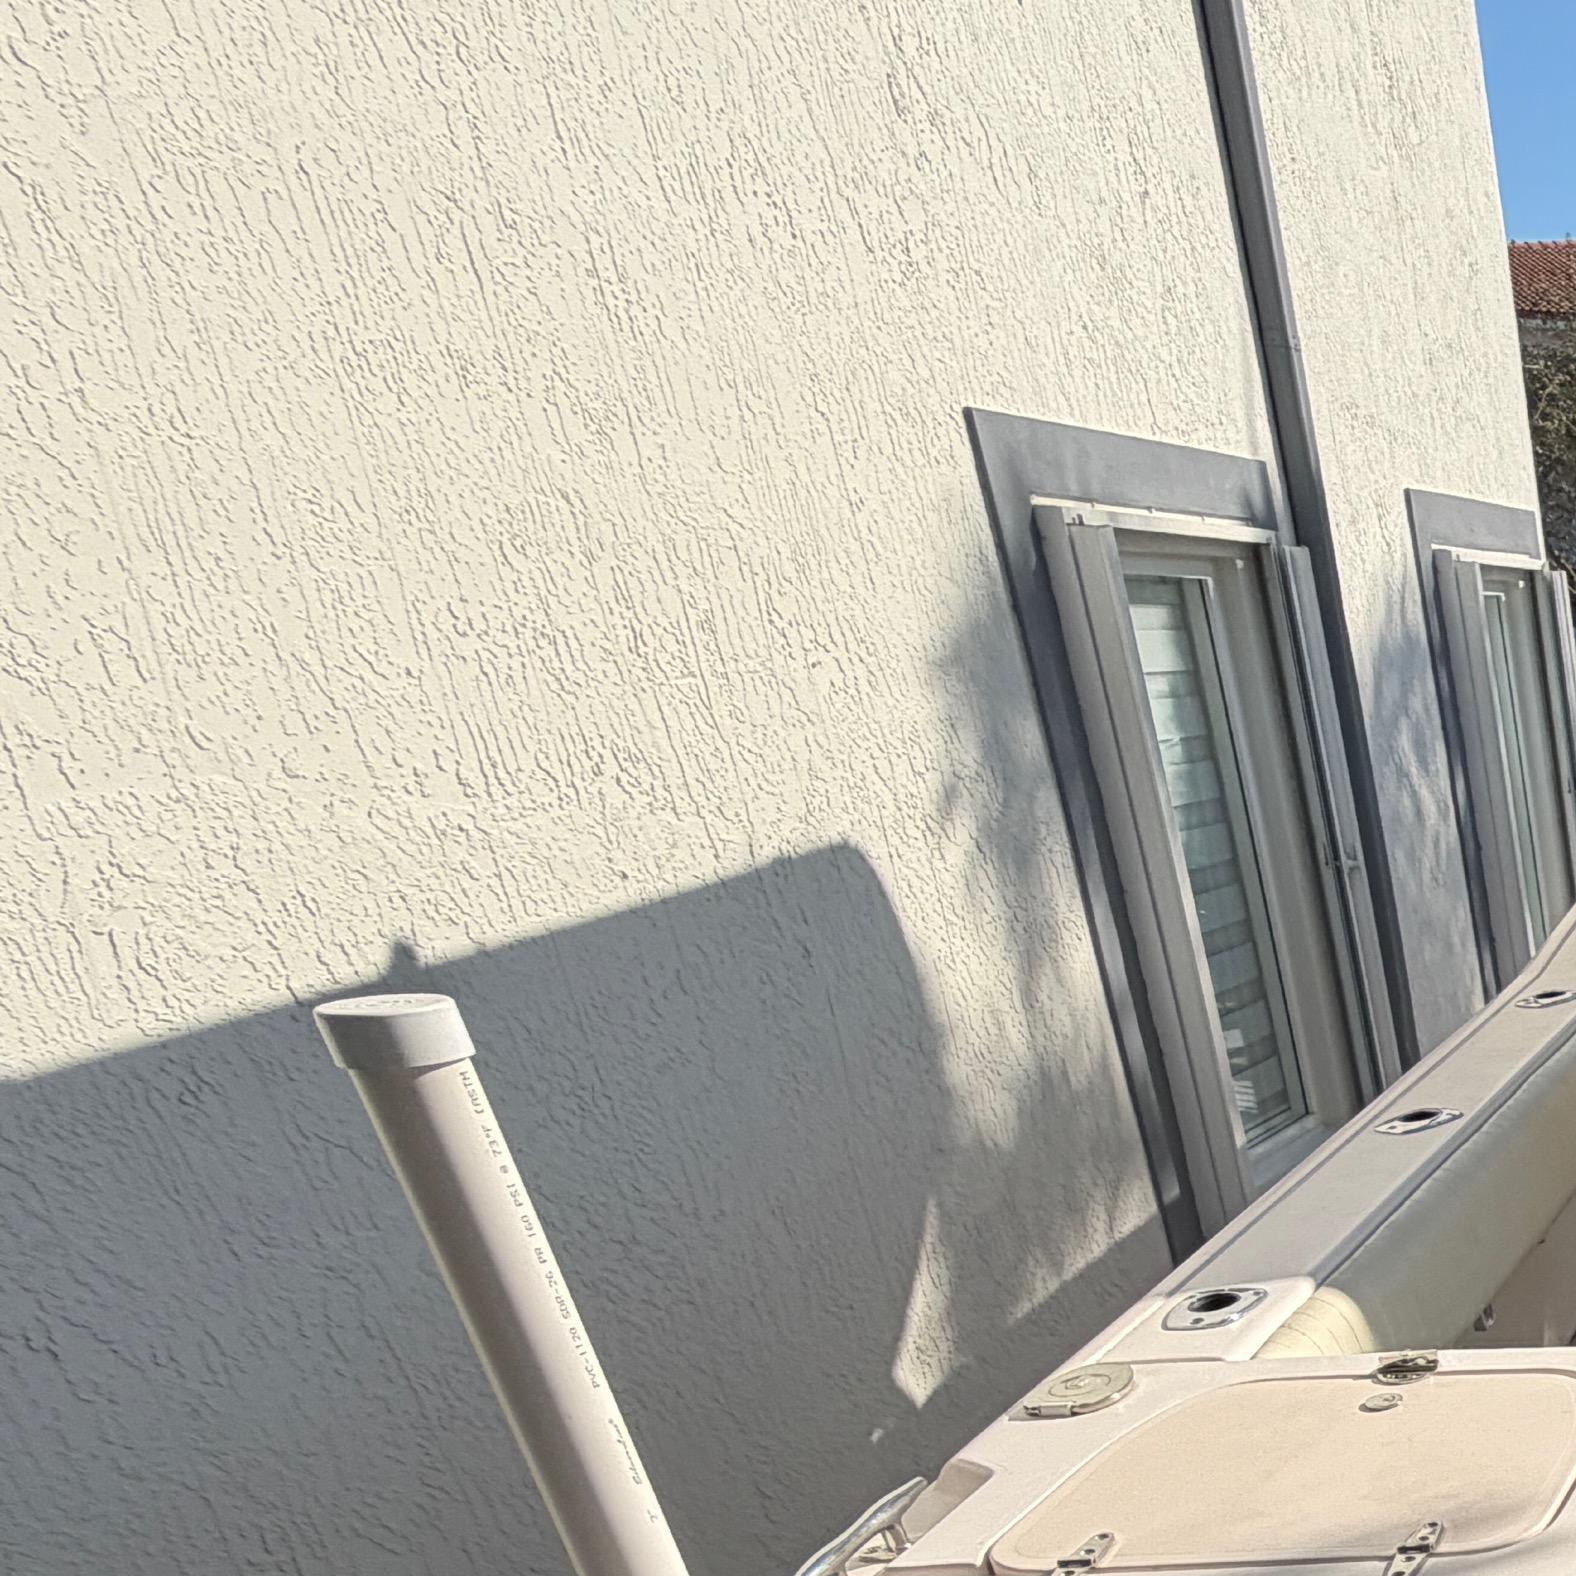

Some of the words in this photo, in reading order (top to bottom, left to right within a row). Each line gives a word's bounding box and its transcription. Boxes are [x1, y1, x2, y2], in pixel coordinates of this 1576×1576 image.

[507, 1183, 522, 1206] PSI
[521, 1215, 535, 1237] 160
[534, 1247, 546, 1263] PR
[568, 1326, 600, 1388] PVC-1120
